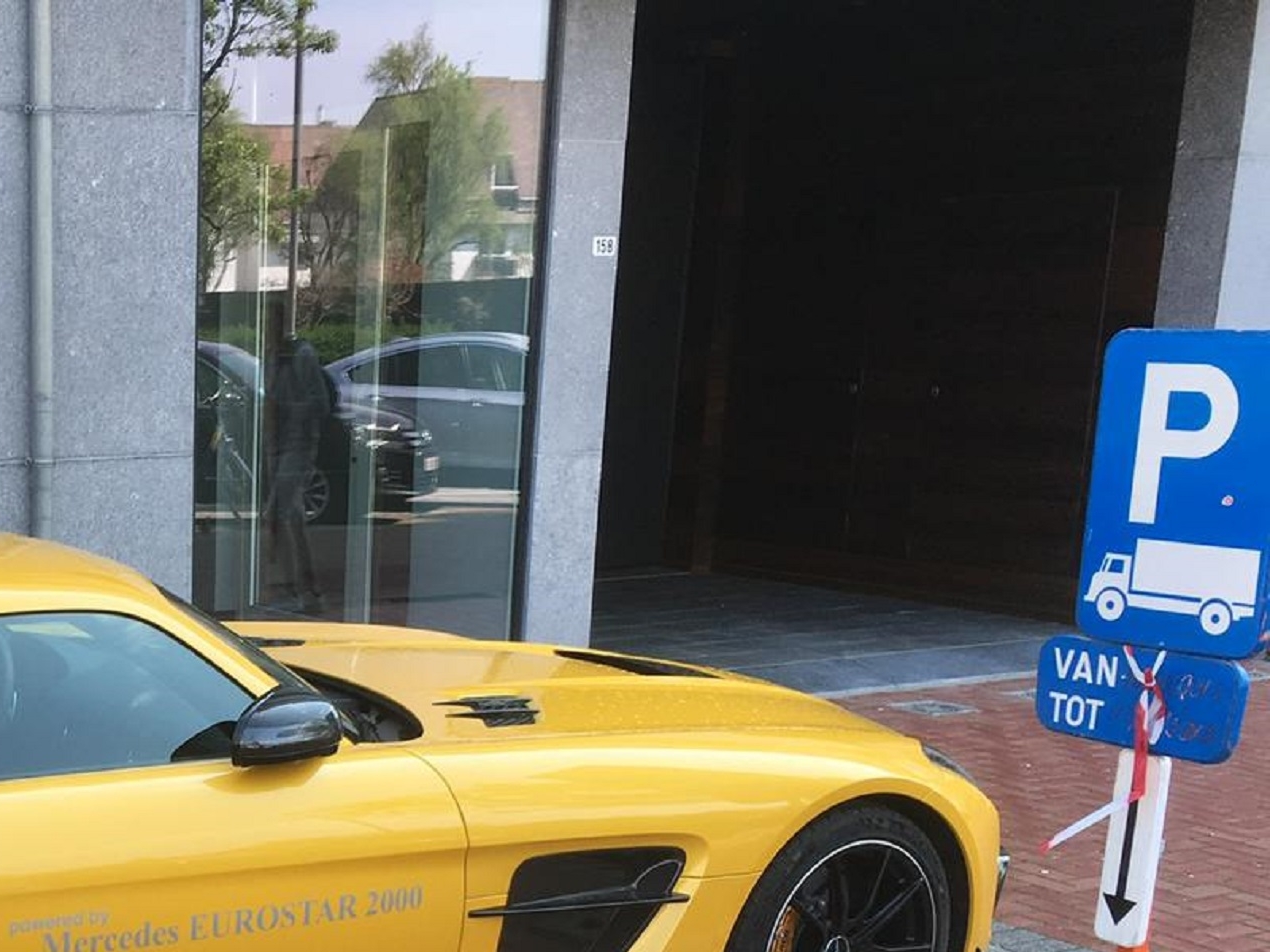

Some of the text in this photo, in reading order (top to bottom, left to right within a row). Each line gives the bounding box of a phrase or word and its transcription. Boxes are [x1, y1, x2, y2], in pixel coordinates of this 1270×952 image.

[1128, 362, 1240, 525] P
[1054, 647, 1118, 687] VAN
[1049, 691, 1105, 730] TOT
[8, 908, 110, 937] powered by
[189, 893, 358, 942] EUROSTAR
[365, 884, 424, 918] 2000
